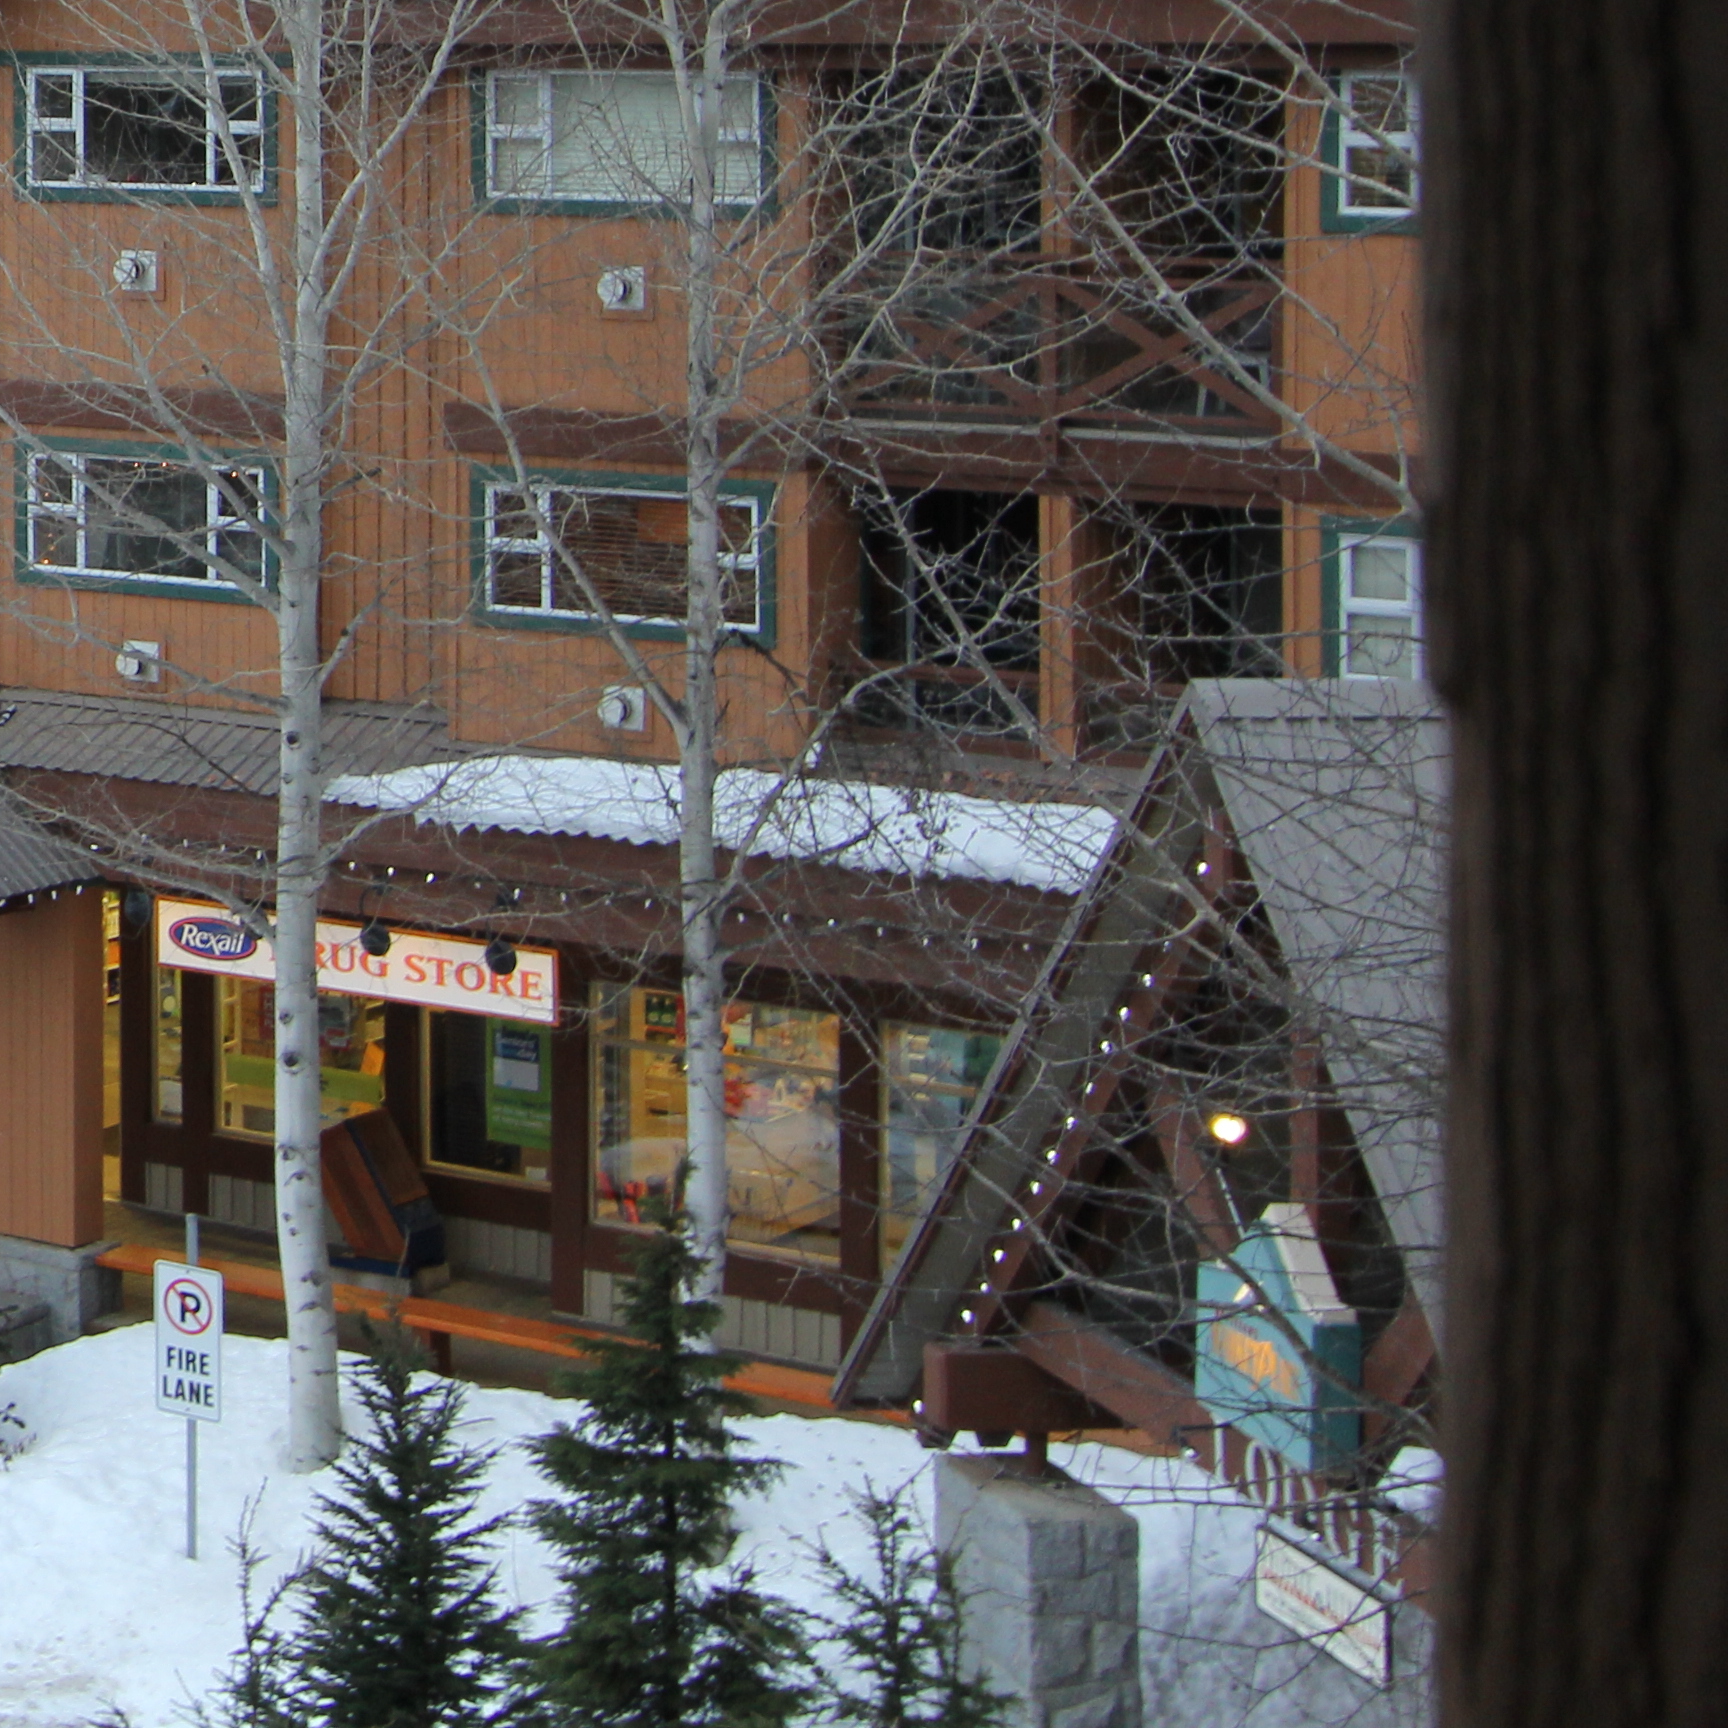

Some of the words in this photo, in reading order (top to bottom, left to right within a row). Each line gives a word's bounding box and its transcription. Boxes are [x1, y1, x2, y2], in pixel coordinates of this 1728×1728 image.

[181, 923, 245, 955] Rexall
[403, 954, 543, 1000] STORE
[167, 1345, 211, 1376] FIRE
[163, 1375, 215, 1407] LANE
